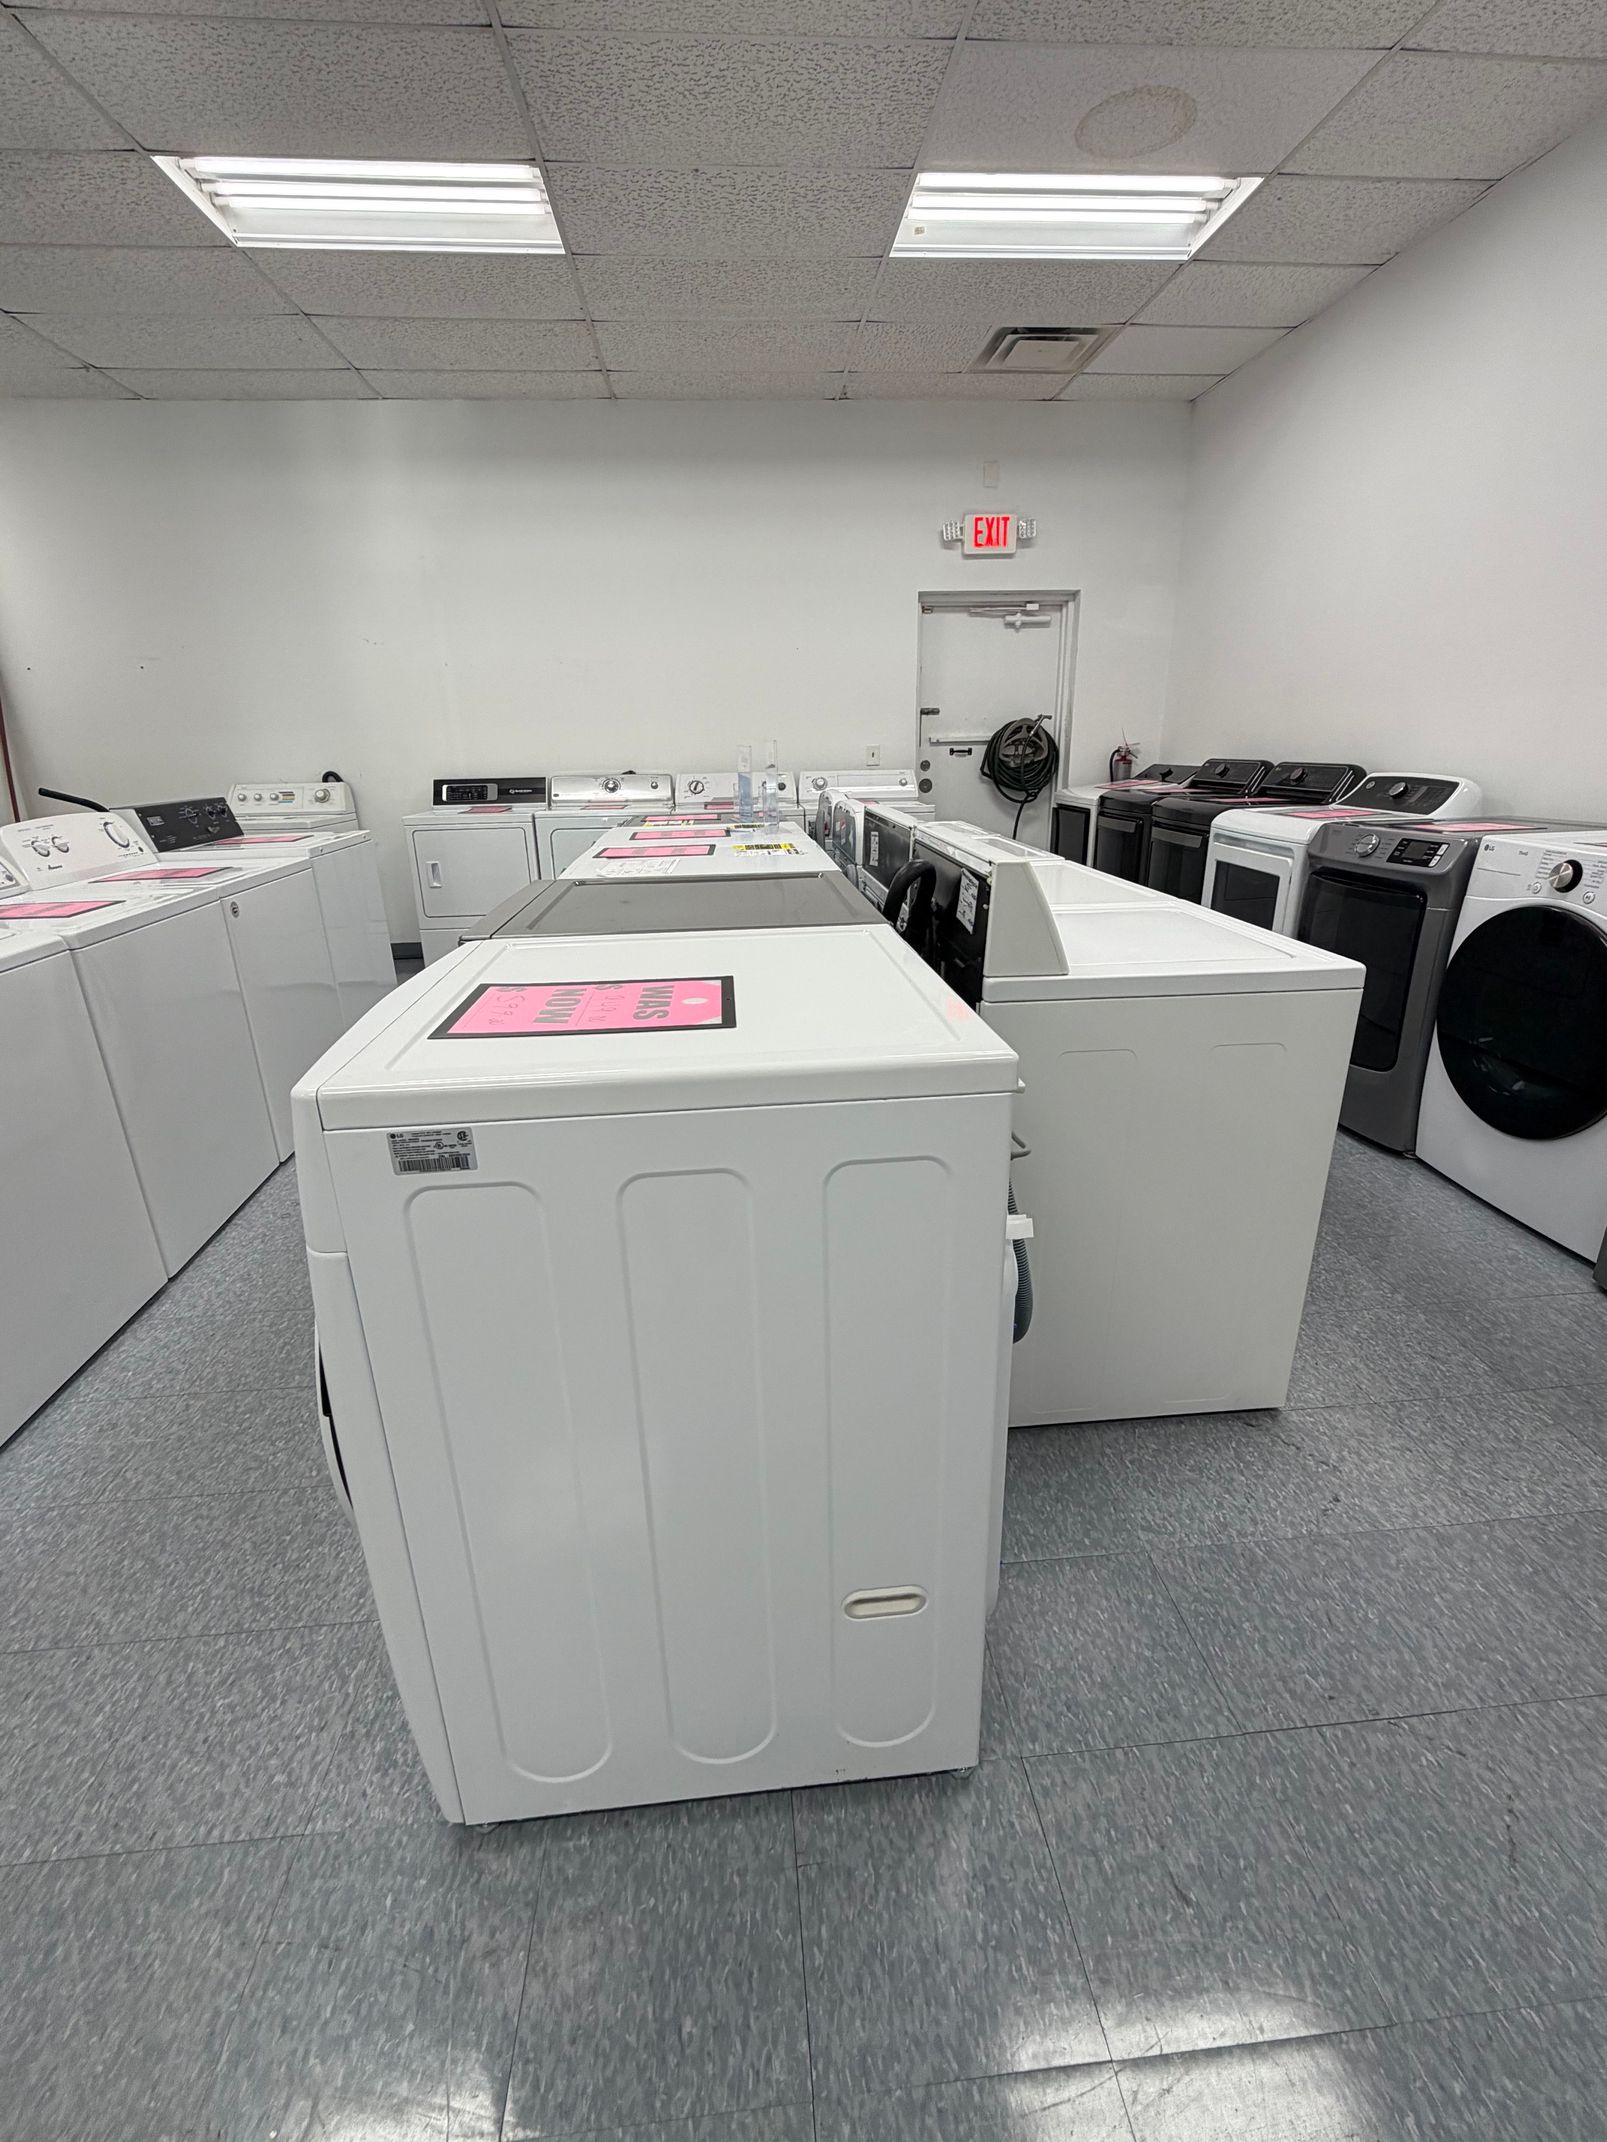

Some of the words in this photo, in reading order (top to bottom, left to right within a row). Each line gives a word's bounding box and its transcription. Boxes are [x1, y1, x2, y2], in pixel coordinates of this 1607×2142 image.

[974, 516, 1010, 547] EXIT
[533, 988, 587, 1024] NOW
[633, 985, 674, 1020] WAS
